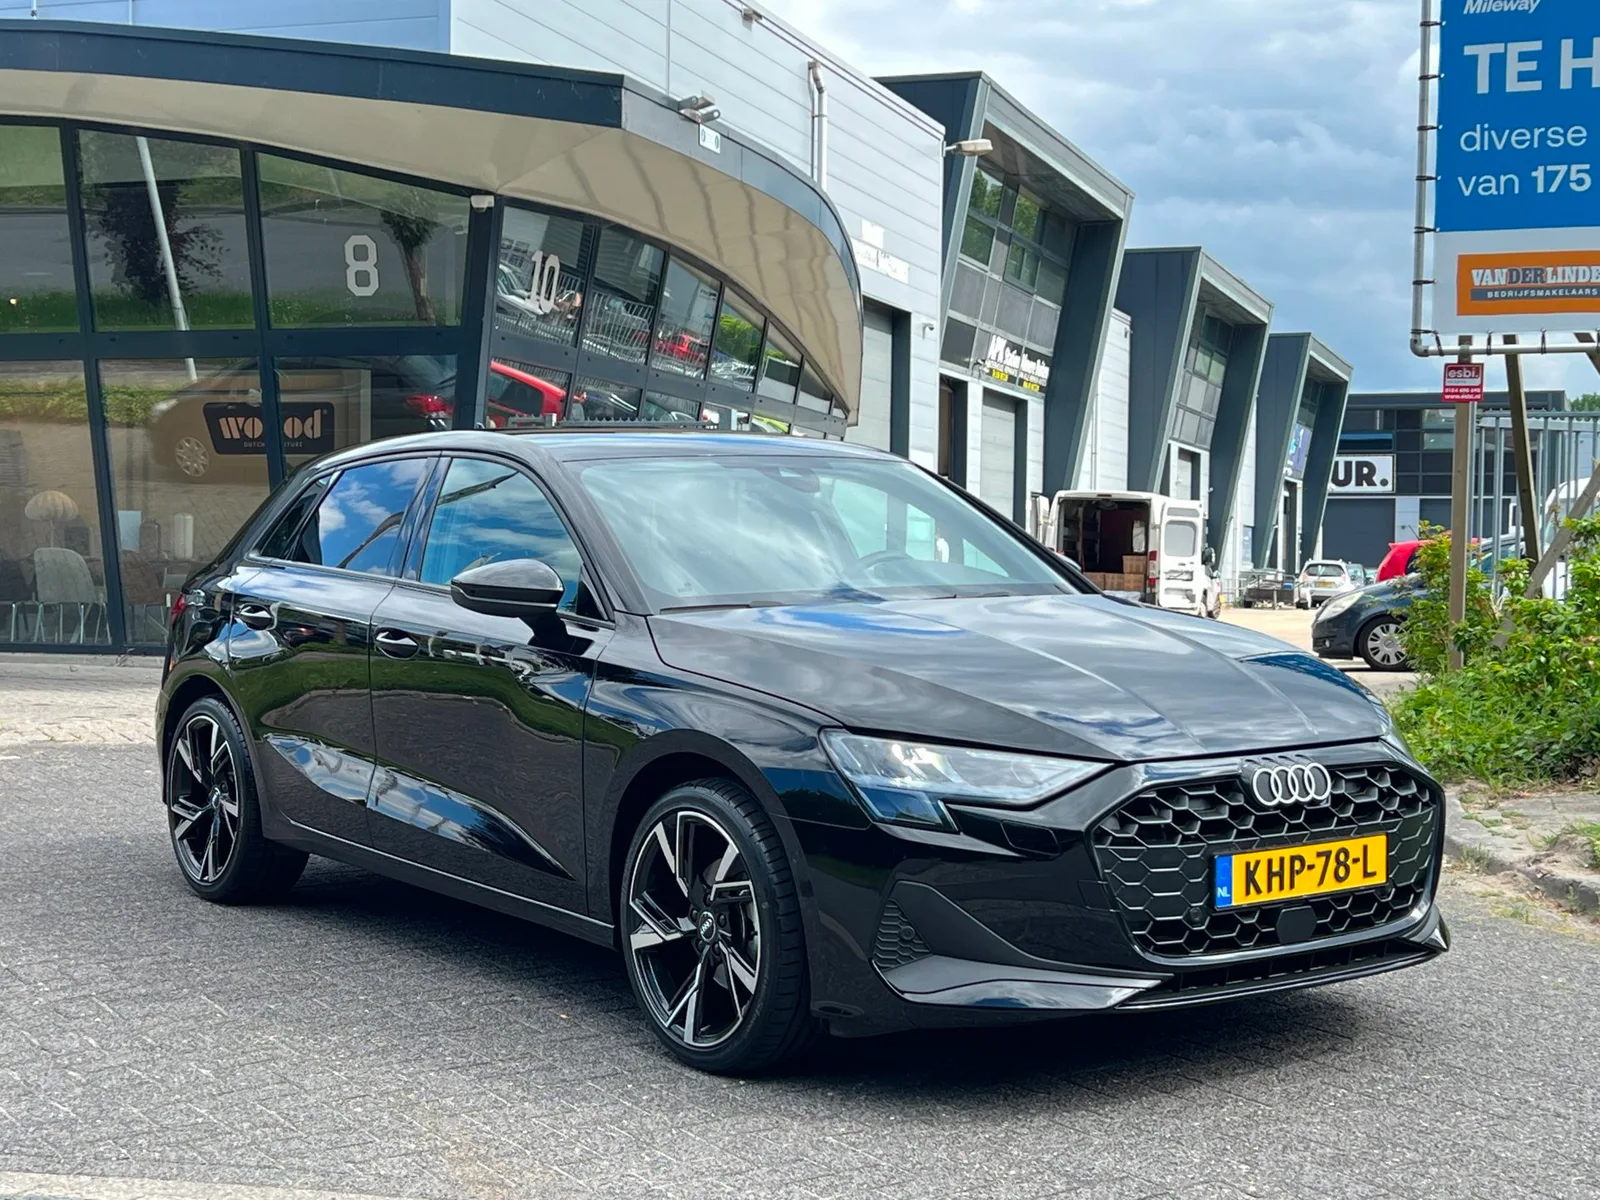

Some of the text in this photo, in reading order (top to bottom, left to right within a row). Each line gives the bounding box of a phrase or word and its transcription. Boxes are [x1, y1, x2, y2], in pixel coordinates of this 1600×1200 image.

[1463, 0, 1542, 14] Mileway
[1463, 37, 1600, 94] TE H
[1460, 123, 1588, 152] diverse
[1457, 164, 1592, 197] van 175
[344, 235, 379, 296] 8
[532, 250, 560, 313] 10
[1487, 288, 1598, 298] BEDRIJFSMAKELAARS
[219, 408, 321, 439] wood
[1331, 460, 1389, 487] UR.
[1245, 844, 1377, 896] KHP-78-L
[1217, 887, 1230, 897] NL
